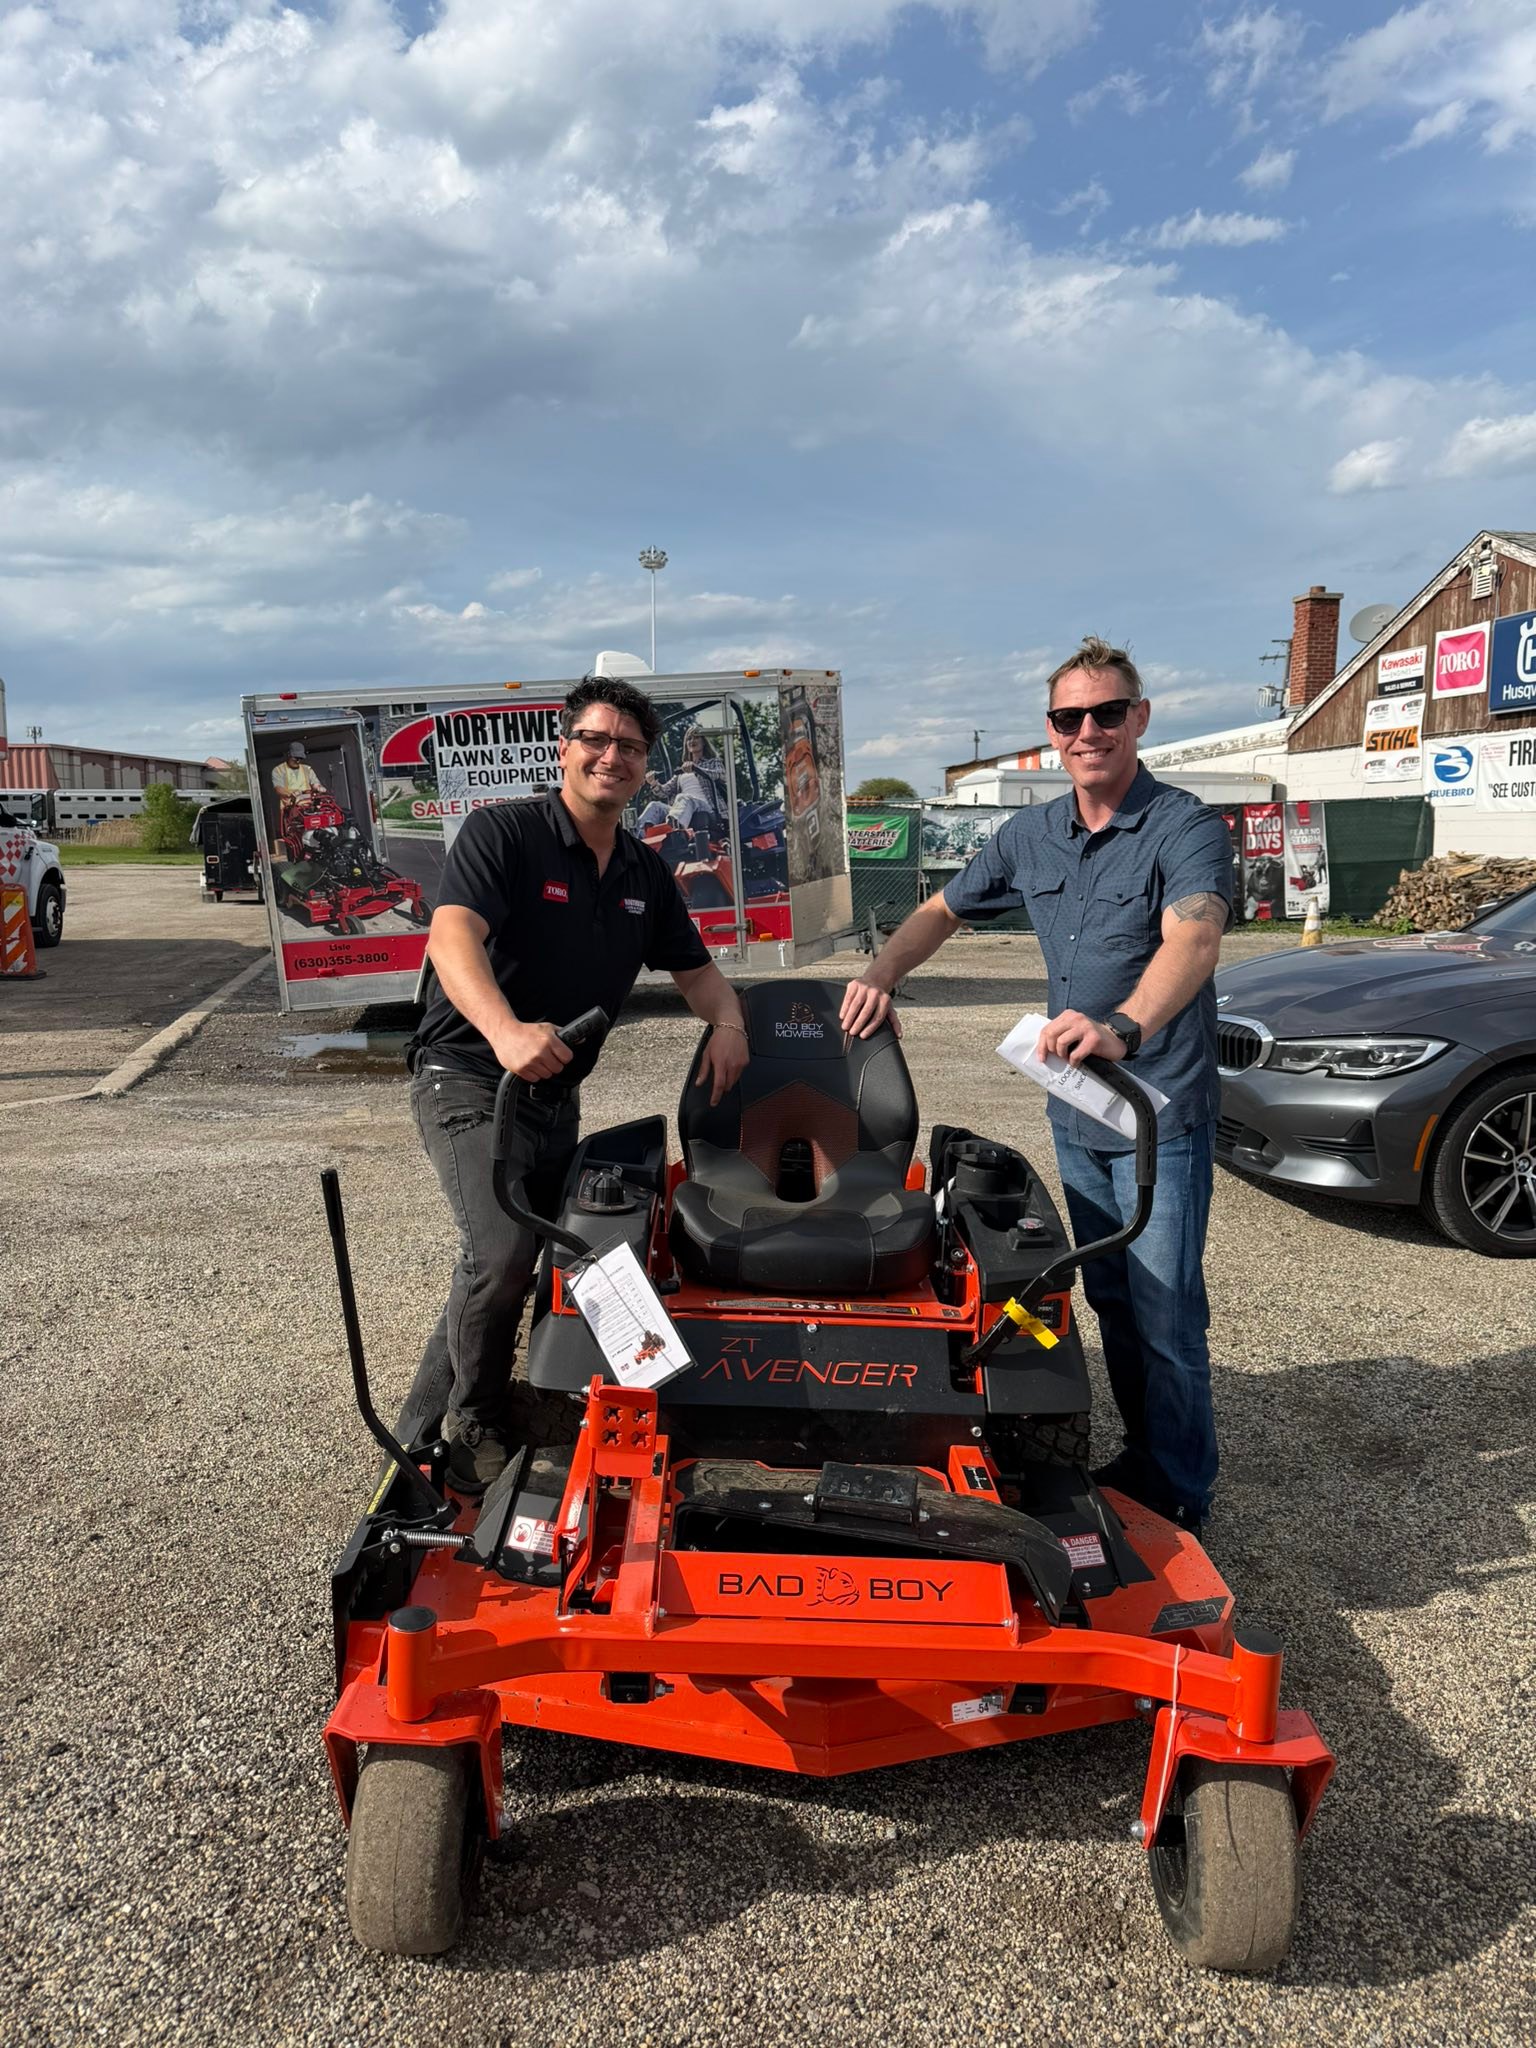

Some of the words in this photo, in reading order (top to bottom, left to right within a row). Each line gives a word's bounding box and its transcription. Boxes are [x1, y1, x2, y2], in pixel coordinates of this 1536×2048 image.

[1381, 651, 1423, 671] Kawasaki
[435, 709, 563, 748] NORTHWE
[438, 749, 495, 768] LAWN
[500, 748, 514, 765] &
[1430, 787, 1474, 798] BLUEBIRD
[413, 800, 462, 817] SALE
[1245, 816, 1281, 833] TORO
[1246, 833, 1281, 850] DAYS
[1290, 835, 1321, 844] STORM
[547, 885, 567, 898] TORO
[329, 943, 351, 952] Lisle
[294, 952, 389, 971] (630)355-3800
[775, 1030, 824, 1039] MOWERS
[776, 1022, 798, 1030] BAD
[801, 1023, 824, 1031] BOY
[721, 1336, 762, 1352] ZT
[700, 1357, 919, 1388] AVENGER
[1070, 1535, 1098, 1547] DANGER
[718, 1573, 804, 1597] BAD
[869, 1578, 954, 1602] BOY
[978, 1702, 990, 1713] 54
